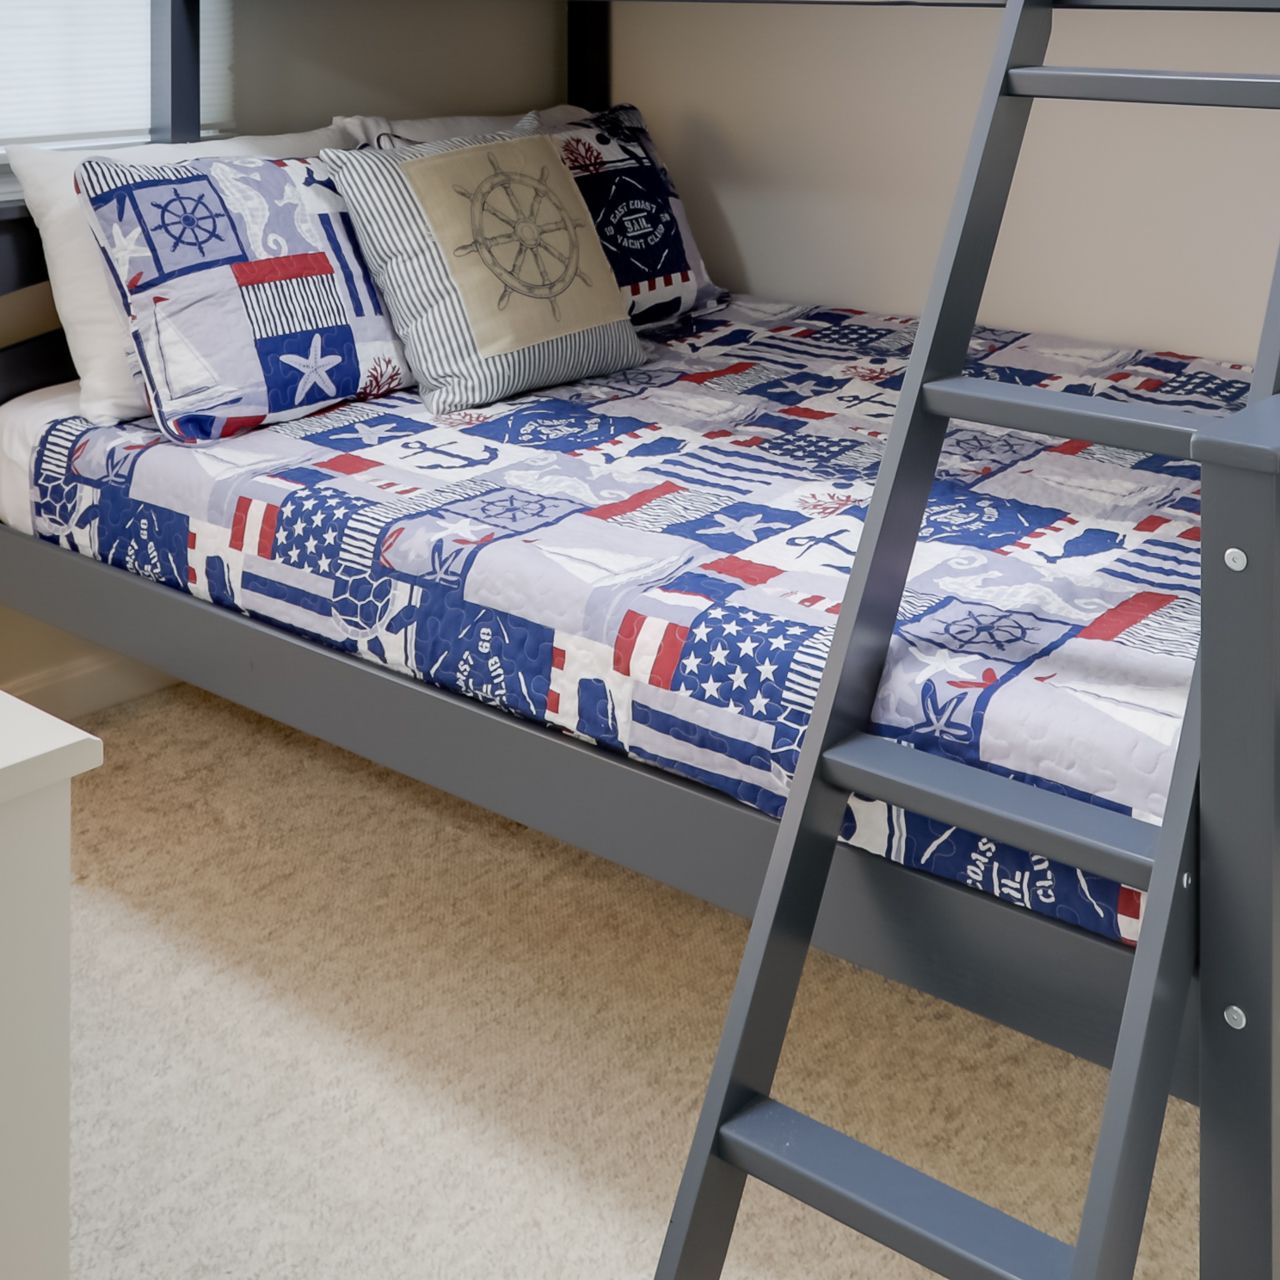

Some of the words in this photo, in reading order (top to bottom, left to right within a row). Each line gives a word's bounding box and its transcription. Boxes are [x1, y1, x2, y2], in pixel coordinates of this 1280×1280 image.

[609, 202, 628, 224] EAST
[628, 199, 657, 214] COAST
[616, 234, 646, 250] YACHT
[647, 223, 665, 245] CLUB
[966, 837, 996, 890] COAS
[1031, 854, 1056, 904] CLU
